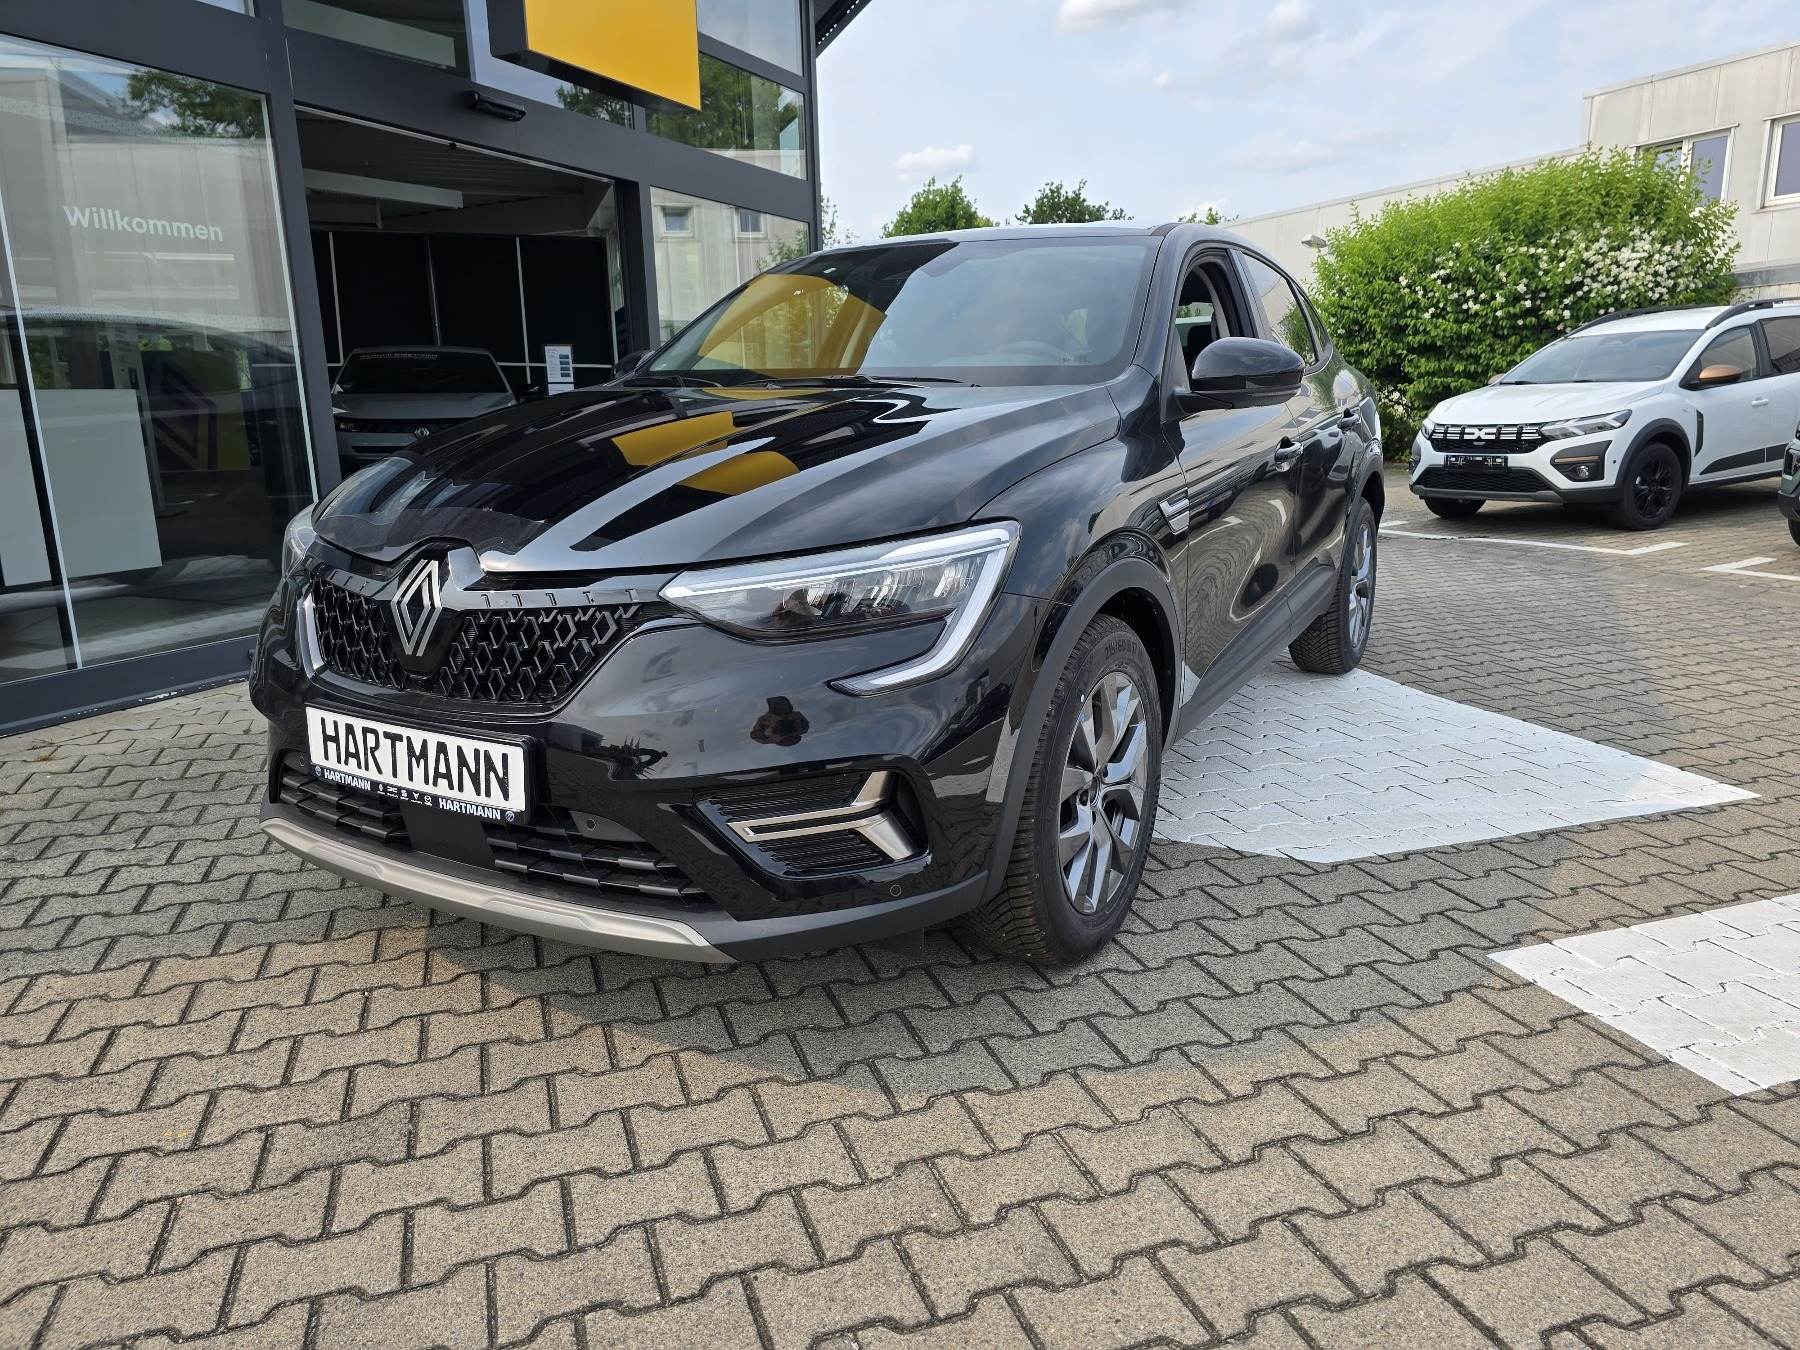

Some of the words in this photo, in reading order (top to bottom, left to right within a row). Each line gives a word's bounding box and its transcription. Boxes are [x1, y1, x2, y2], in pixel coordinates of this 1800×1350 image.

[62, 205, 224, 242] Willkommen
[320, 716, 510, 802] HARTMANN
[324, 768, 371, 791] HARTMANN
[438, 797, 501, 820] HARTMANN
